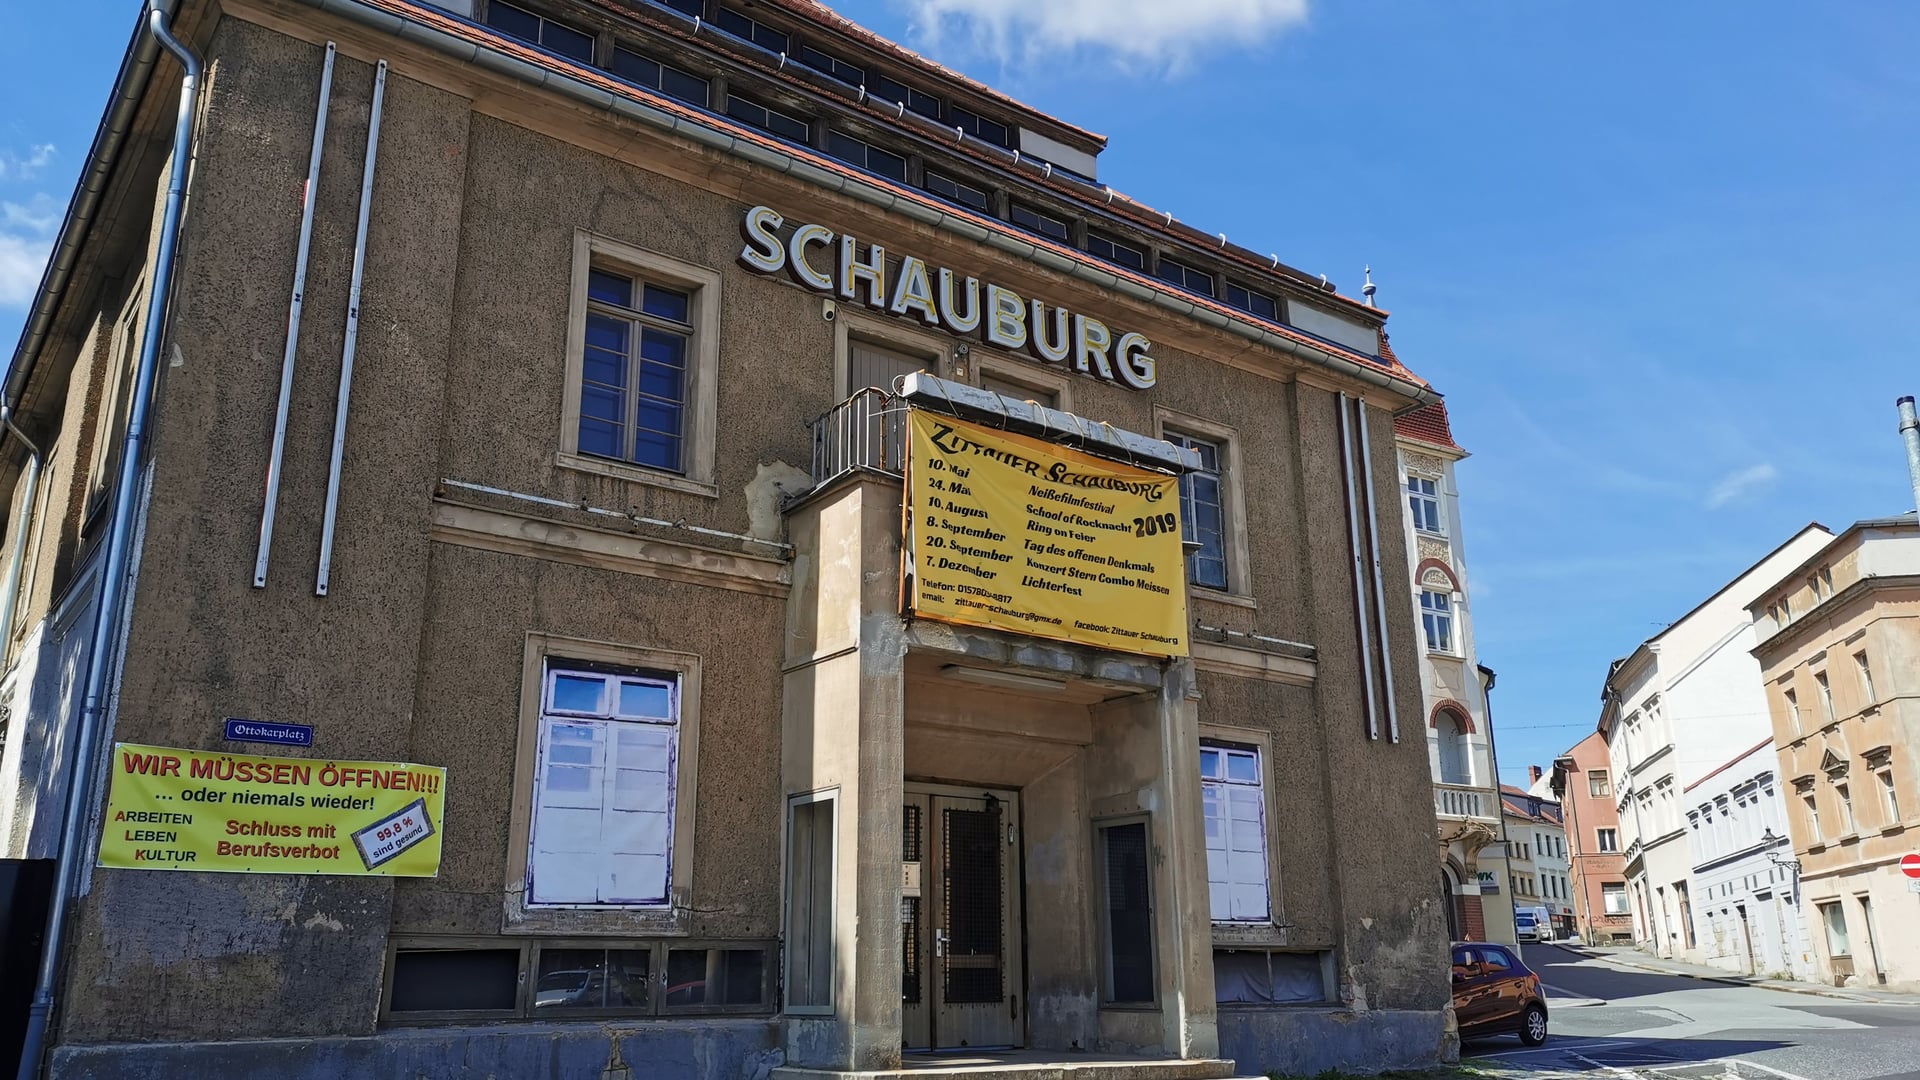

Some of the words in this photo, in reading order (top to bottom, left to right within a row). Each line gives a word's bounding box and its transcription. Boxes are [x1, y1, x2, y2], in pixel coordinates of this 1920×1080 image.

[737, 204, 1157, 390] SCHAUBURG
[928, 458, 946, 471] 10.
[949, 464, 970, 478] Mai
[928, 477, 946, 491] 24.
[928, 496, 944, 510] 10.
[945, 501, 989, 519] August
[1028, 485, 1116, 515] Neißefilmfestival
[926, 516, 938, 528] 8.
[941, 518, 1006, 542] September
[1026, 504, 1063, 521] School
[1063, 514, 1076, 524] of
[1076, 515, 1132, 533] Rocknacht
[1133, 512, 1177, 538] 2019
[1026, 519, 1052, 536] Ring
[1054, 527, 1067, 537] on
[1069, 530, 1096, 543] Feier
[926, 535, 947, 549] 20.
[949, 539, 1013, 563] September
[1024, 538, 1045, 554] Tag
[1046, 543, 1066, 556] des
[1067, 549, 1106, 565] offenen
[1107, 556, 1155, 574] Denkmals
[926, 555, 936, 568] 7.
[938, 557, 997, 580] Dezember
[1026, 557, 1066, 576] Konzert
[1068, 567, 1097, 582] Stern
[1099, 573, 1135, 588] Combo
[1136, 577, 1170, 595] Meissen
[921, 578, 955, 592] Telefon:
[1021, 575, 1083, 597] Lichterfest
[1111, 626, 1140, 638] Zittauer
[1140, 631, 1178, 645] Schauburg
[234, 724, 305, 742] Ottokarplatz
[123, 752, 181, 778] WIR
[189, 756, 311, 786] MÜSSEN
[318, 761, 440, 794] ÖFFNEN!!!
[181, 787, 227, 803] oder
[232, 789, 305, 808] niemals
[310, 794, 375, 810] wieder!
[115, 810, 193, 825] ARBEITEN
[226, 819, 301, 838] Schluss
[307, 822, 337, 839] mit
[376, 822, 402, 841] 99,8
[402, 816, 414, 828] %
[125, 829, 177, 843] LEBEN
[373, 842, 394, 859] sind
[395, 825, 423, 849] gesund
[135, 849, 196, 862] KULTUR
[216, 840, 340, 860] Berufsverbot
